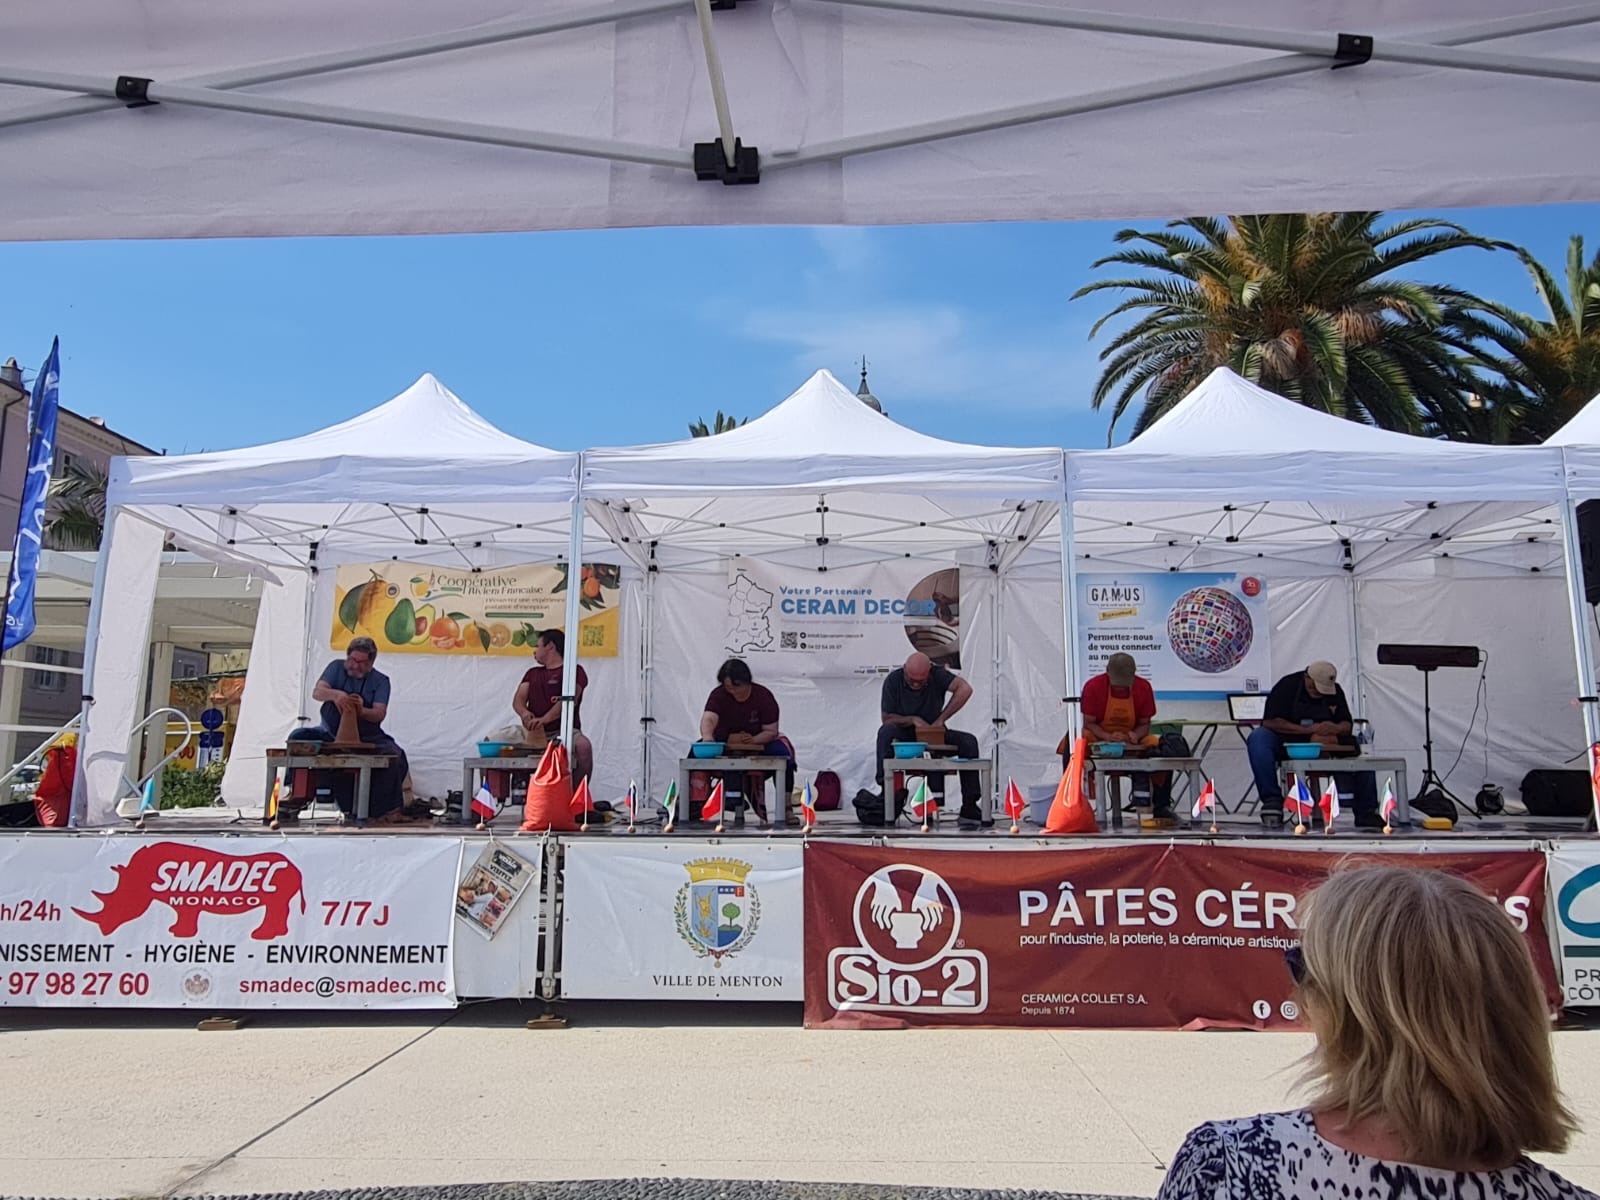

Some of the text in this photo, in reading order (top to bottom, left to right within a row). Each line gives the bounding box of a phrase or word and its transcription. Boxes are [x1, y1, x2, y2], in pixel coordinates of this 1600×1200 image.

[437, 574, 517, 592] Coopérative
[779, 586, 873, 596] Votre Partenaire
[780, 599, 936, 615] CERAM DECOR
[1087, 633, 1153, 641] Permettez-nous
[151, 861, 288, 892] SMADEC
[169, 897, 260, 906] MONACO
[1019, 881, 1178, 927] PÂTES
[1020, 934, 1047, 946] pour
[1050, 932, 1106, 945] l'industrie,
[1109, 932, 1119, 944] la
[1122, 932, 1167, 946] poterie,
[1169, 932, 1179, 944] la
[1182, 934, 1245, 948] céramique
[144, 940, 236, 963] HYGIÈNE
[266, 945, 448, 964] ENVIRONNEMENT
[8, 972, 149, 995] 97 98 27 60
[239, 977, 446, 998] smadec@smadec.mc
[653, 975, 783, 988] VILLE DE MENTON
[838, 955, 976, 1006] Sio-2
[1021, 994, 1148, 1005] CERAMICA COLLET S.A.
[1021, 1007, 1076, 1017] Depuis 1874
